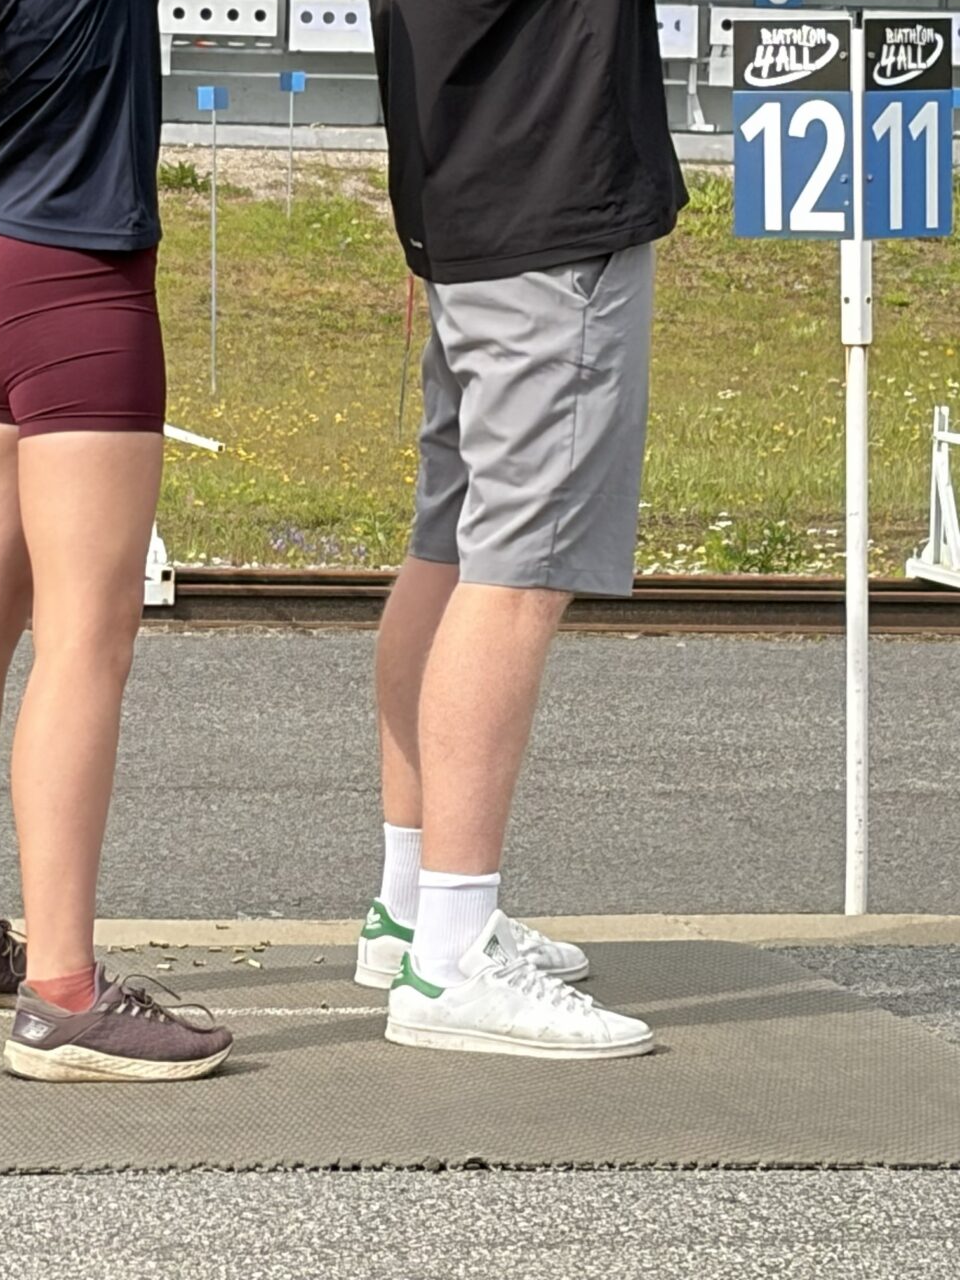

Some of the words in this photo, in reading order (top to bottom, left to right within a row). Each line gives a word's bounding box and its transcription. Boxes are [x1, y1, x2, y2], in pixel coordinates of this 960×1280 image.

[760, 24, 827, 48] BIATHLON
[885, 24, 934, 46] BIATHLON
[740, 99, 845, 232] 12
[872, 101, 938, 230] 11
